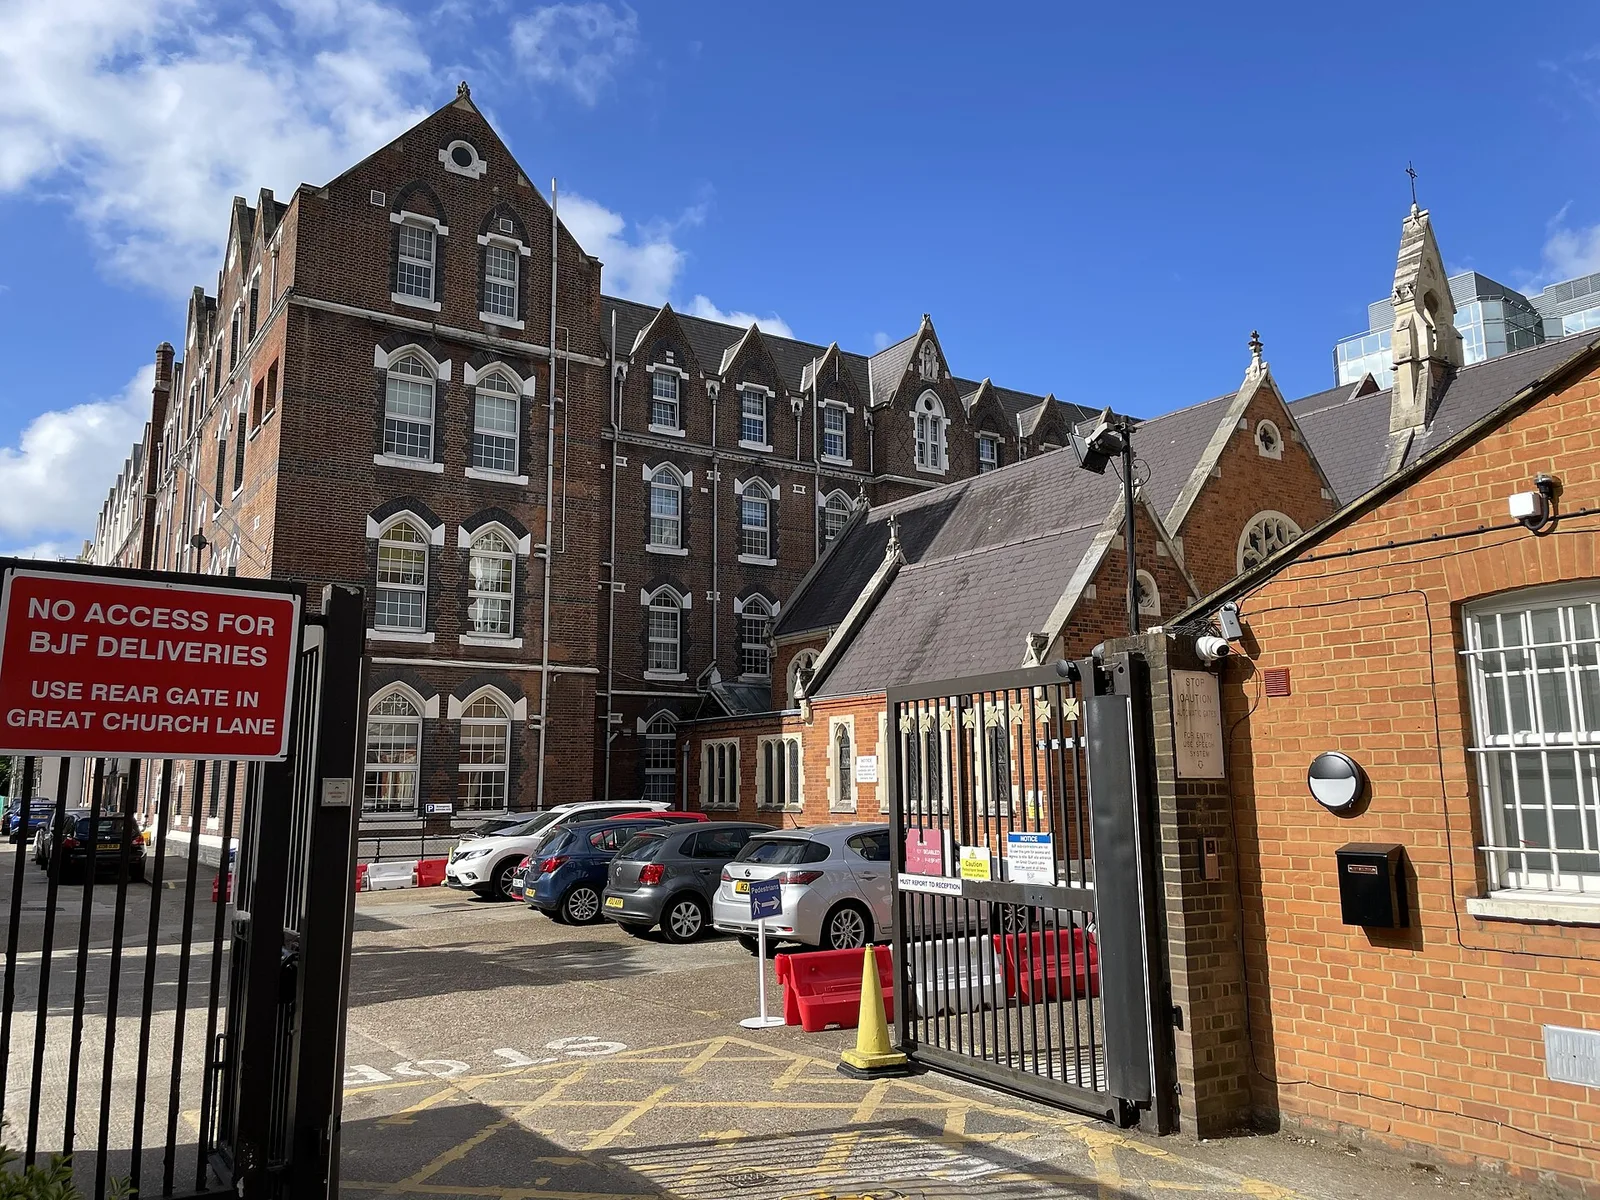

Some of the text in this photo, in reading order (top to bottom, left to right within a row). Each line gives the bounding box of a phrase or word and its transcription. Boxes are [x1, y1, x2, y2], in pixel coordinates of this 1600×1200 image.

[28, 597, 275, 637] NO ACCESS FOR
[29, 631, 268, 668] BJF DELIVERIES
[1185, 677, 1205, 687] STOP
[31, 680, 259, 708] USE REAR GATE IN
[6, 708, 276, 736] GREAT CHURCH LANE
[965, 860, 983, 868] Caution
[751, 884, 779, 894] Pedestrians
[911, 879, 928, 887] REPORT
[936, 881, 961, 890] RECEPTION
